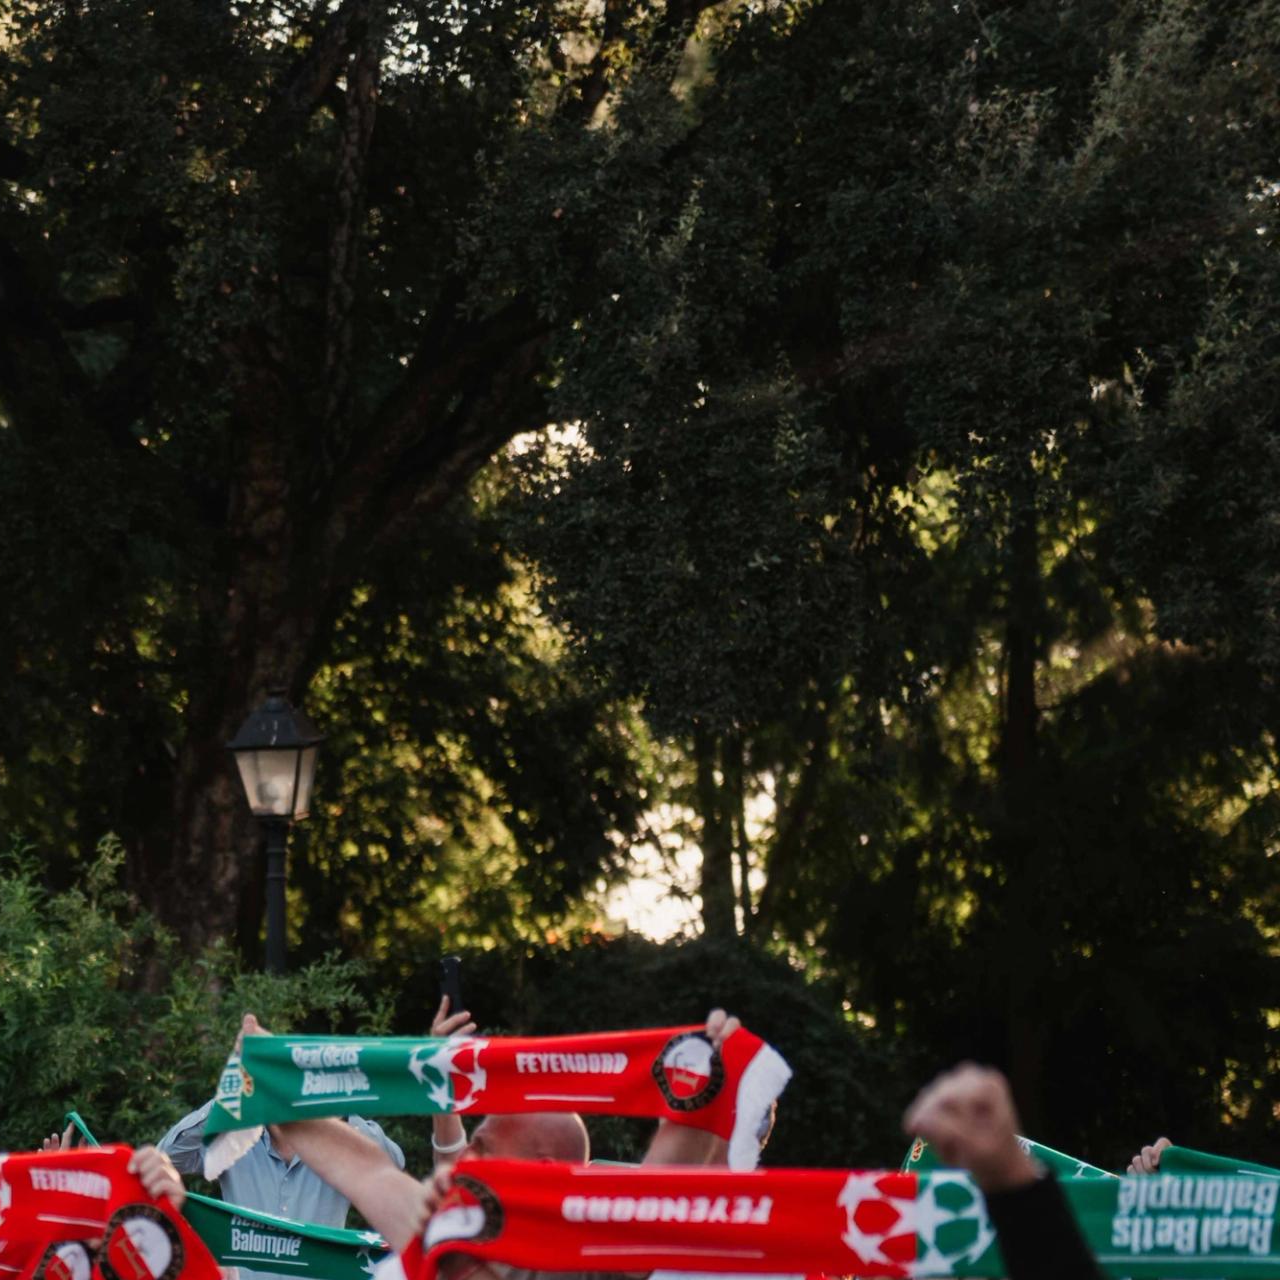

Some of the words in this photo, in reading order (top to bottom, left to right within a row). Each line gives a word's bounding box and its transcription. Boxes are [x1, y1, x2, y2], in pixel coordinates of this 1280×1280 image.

[515, 1052, 628, 1075] FEYENOORD
[561, 1195, 773, 1225] FEYENOORD
[1116, 1174, 1279, 1218] Balompié
[231, 1227, 302, 1258] Balompié
[1111, 1215, 1199, 1256] Betis
[1200, 1216, 1275, 1257] Real
